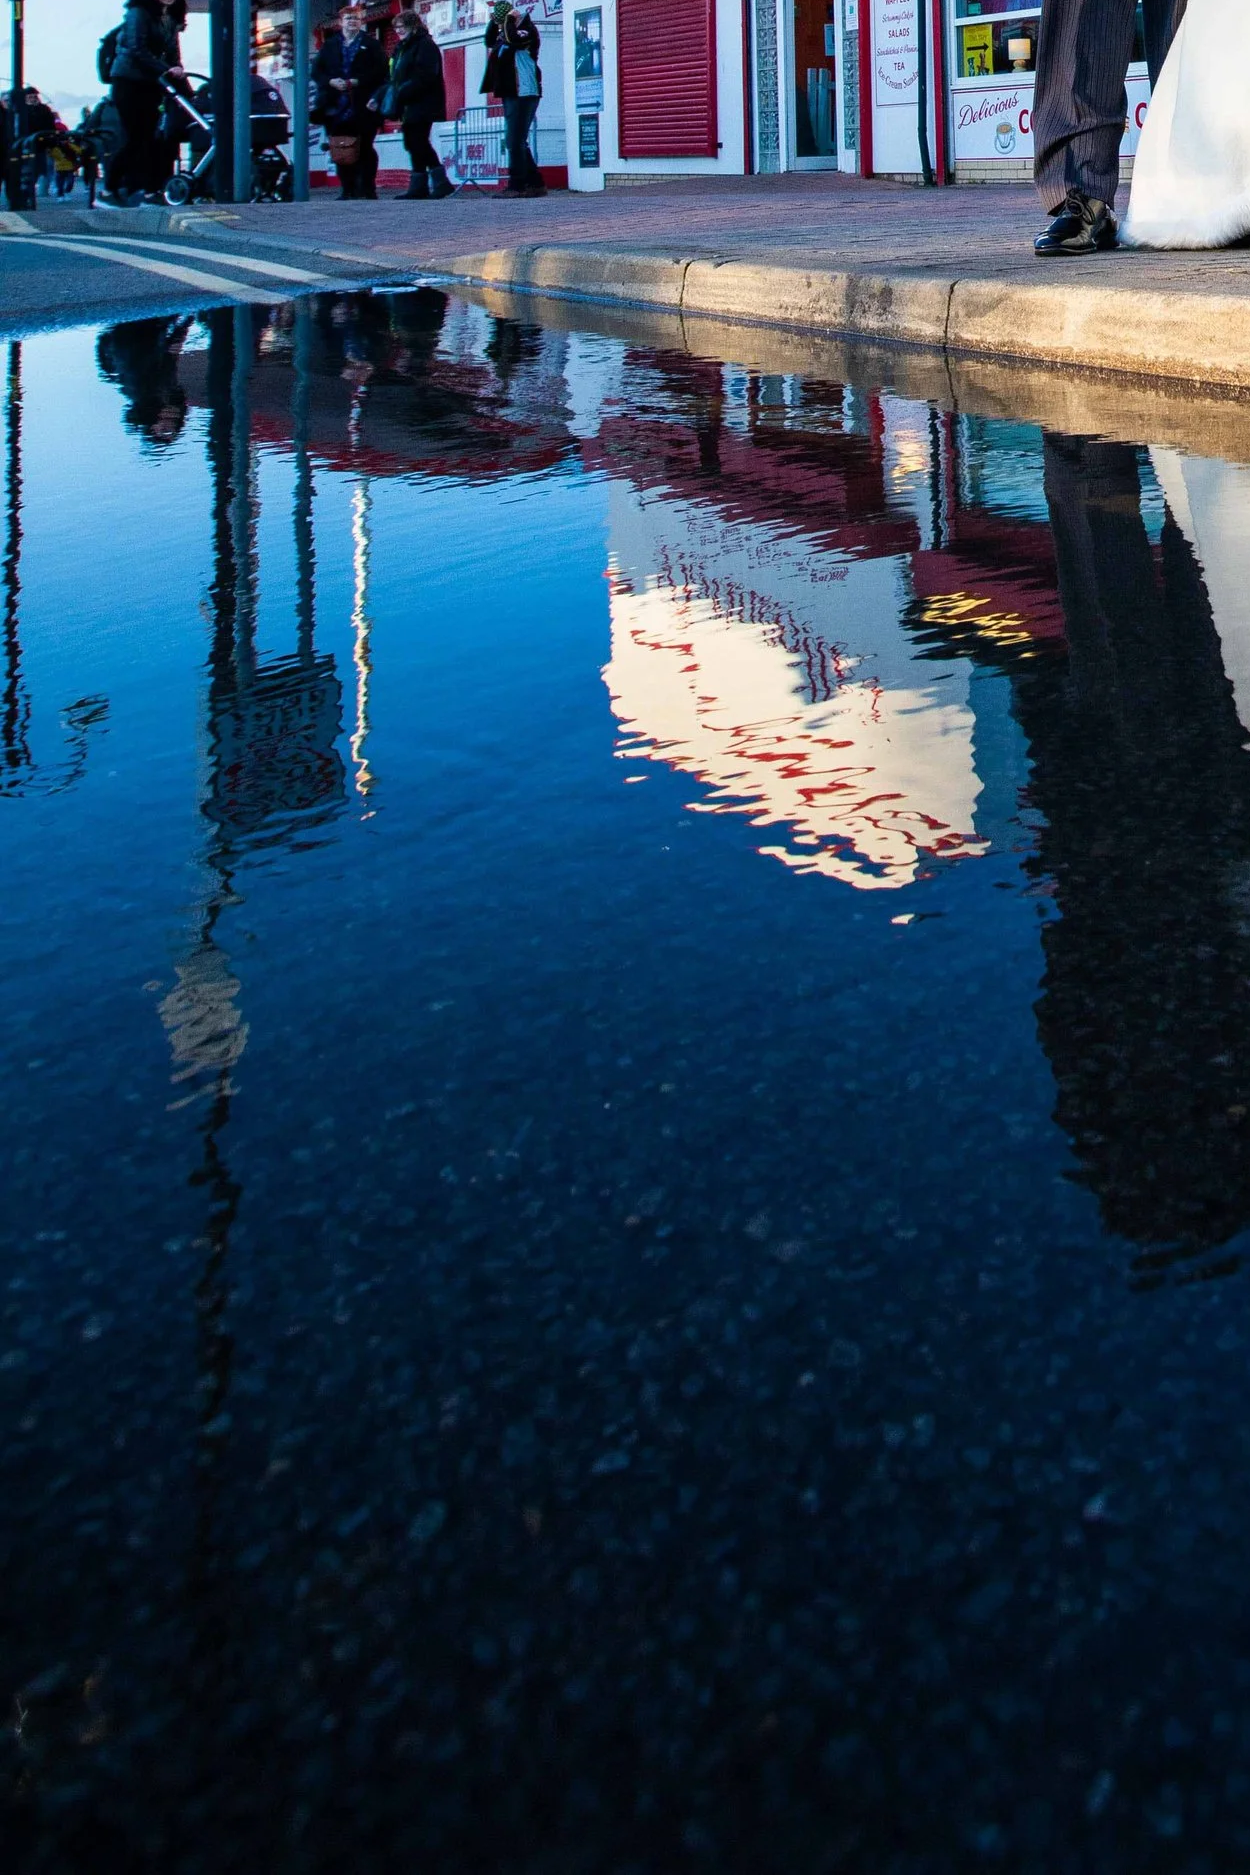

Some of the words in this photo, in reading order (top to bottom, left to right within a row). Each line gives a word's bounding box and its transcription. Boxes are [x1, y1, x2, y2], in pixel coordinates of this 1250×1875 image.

[888, 27, 910, 39] SALADS
[893, 62, 905, 71] TEA
[958, 91, 1020, 129] Delicious
